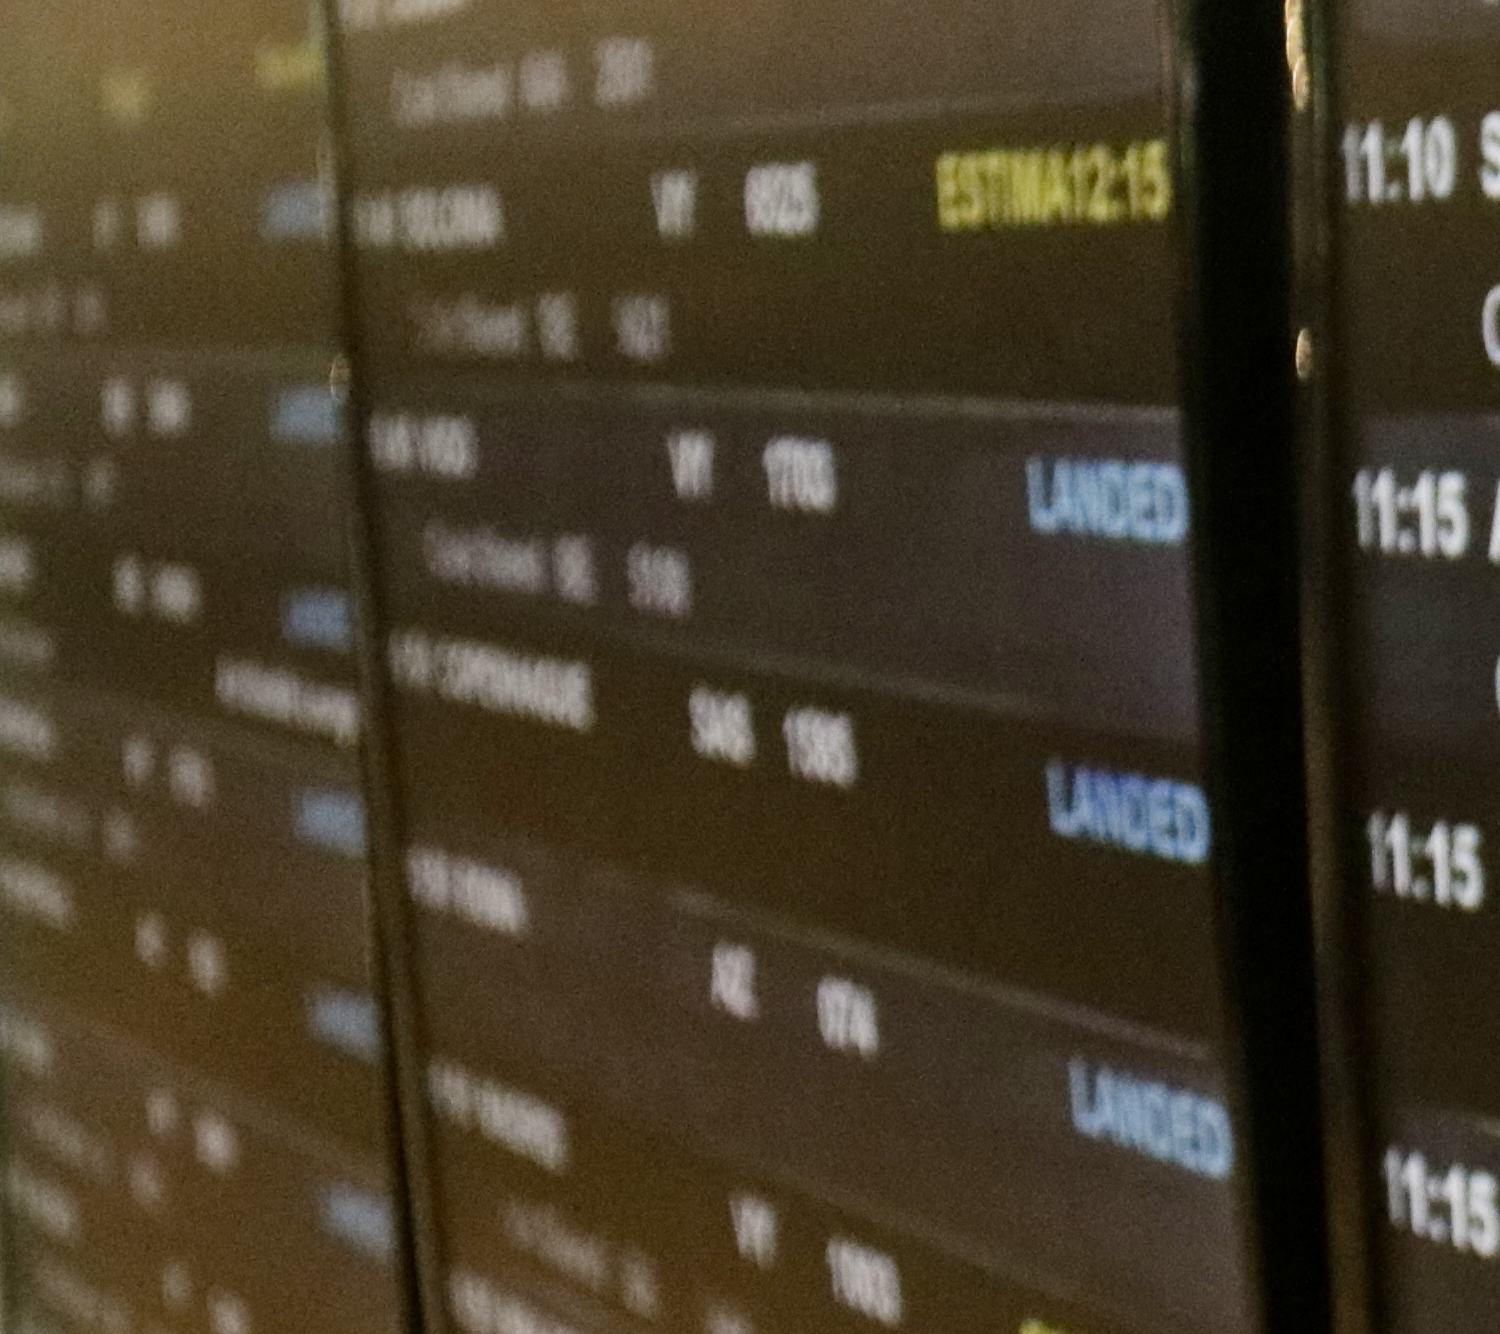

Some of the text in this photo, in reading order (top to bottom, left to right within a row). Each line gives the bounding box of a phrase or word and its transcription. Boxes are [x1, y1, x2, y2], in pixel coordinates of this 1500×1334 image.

[937, 141, 1169, 227] ESTIMA12:15
[1346, 117, 1455, 201] 11:10
[1030, 461, 1187, 542] LANDED
[1357, 470, 1468, 557] 11:15
[1050, 771, 1209, 862] LANDED
[1372, 817, 1483, 908] 11:15
[1073, 1072, 1231, 1177] LANDED
[1388, 1155, 1500, 1256] 11:15
